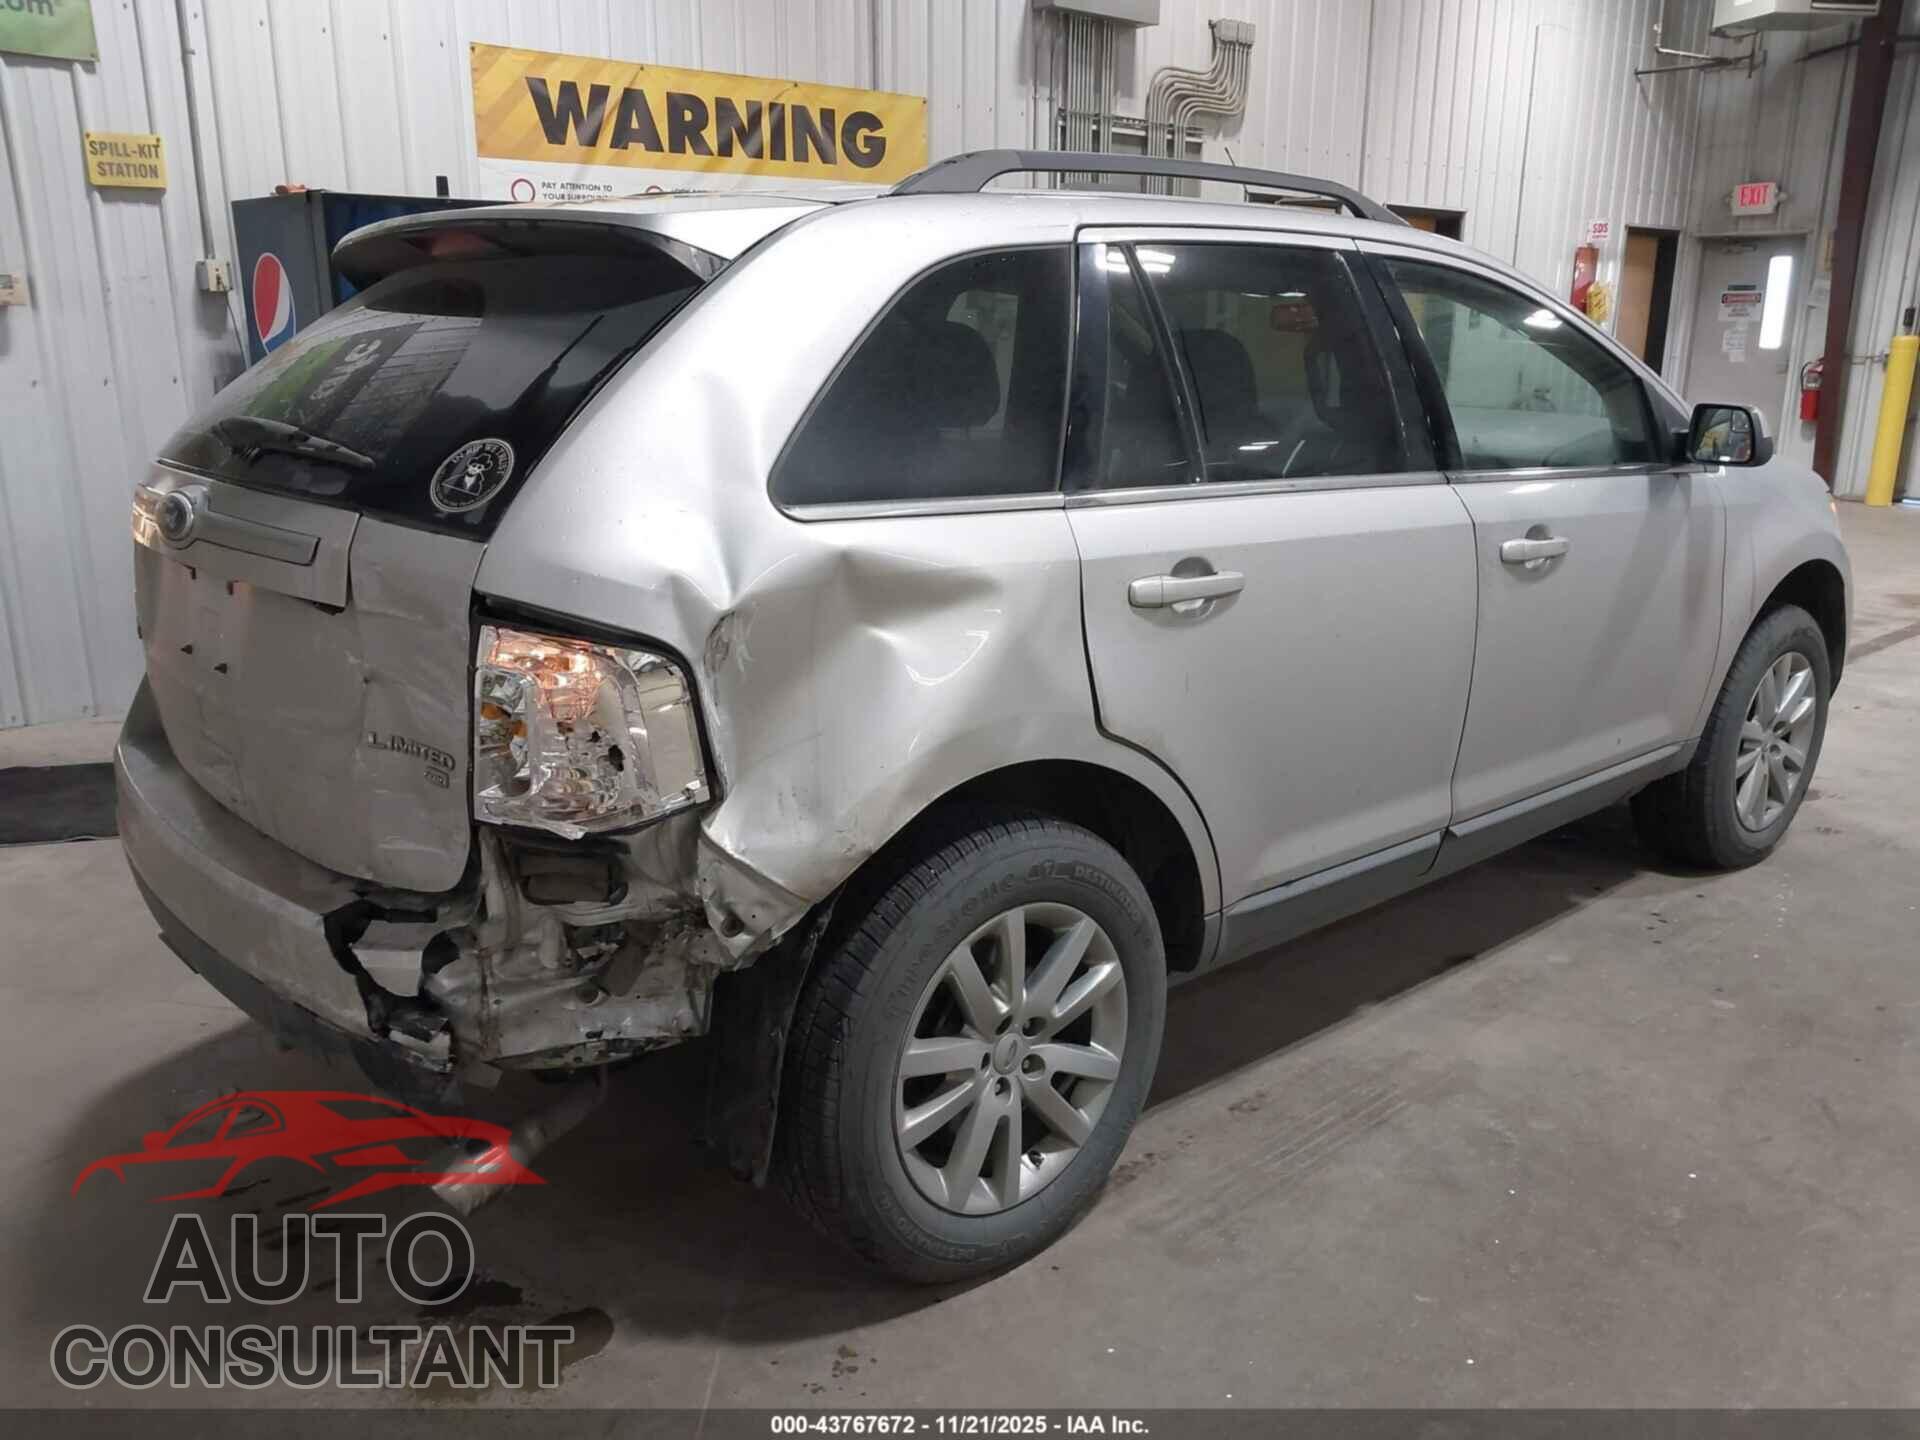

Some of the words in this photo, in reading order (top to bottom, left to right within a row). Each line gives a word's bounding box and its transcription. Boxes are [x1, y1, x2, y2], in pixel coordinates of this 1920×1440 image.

[525, 76, 887, 169] WARNING
[89, 140, 160, 159] SPILL-KIT
[96, 161, 159, 179] STATION
[541, 181, 557, 190] PAY
[560, 182, 601, 192] ATTENTION
[603, 184, 613, 192] TO
[543, 192, 566, 200] YOUR
[1740, 184, 1769, 208] EXIT
[1593, 222, 1608, 234] SDS
[367, 730, 456, 771] LIMITED
